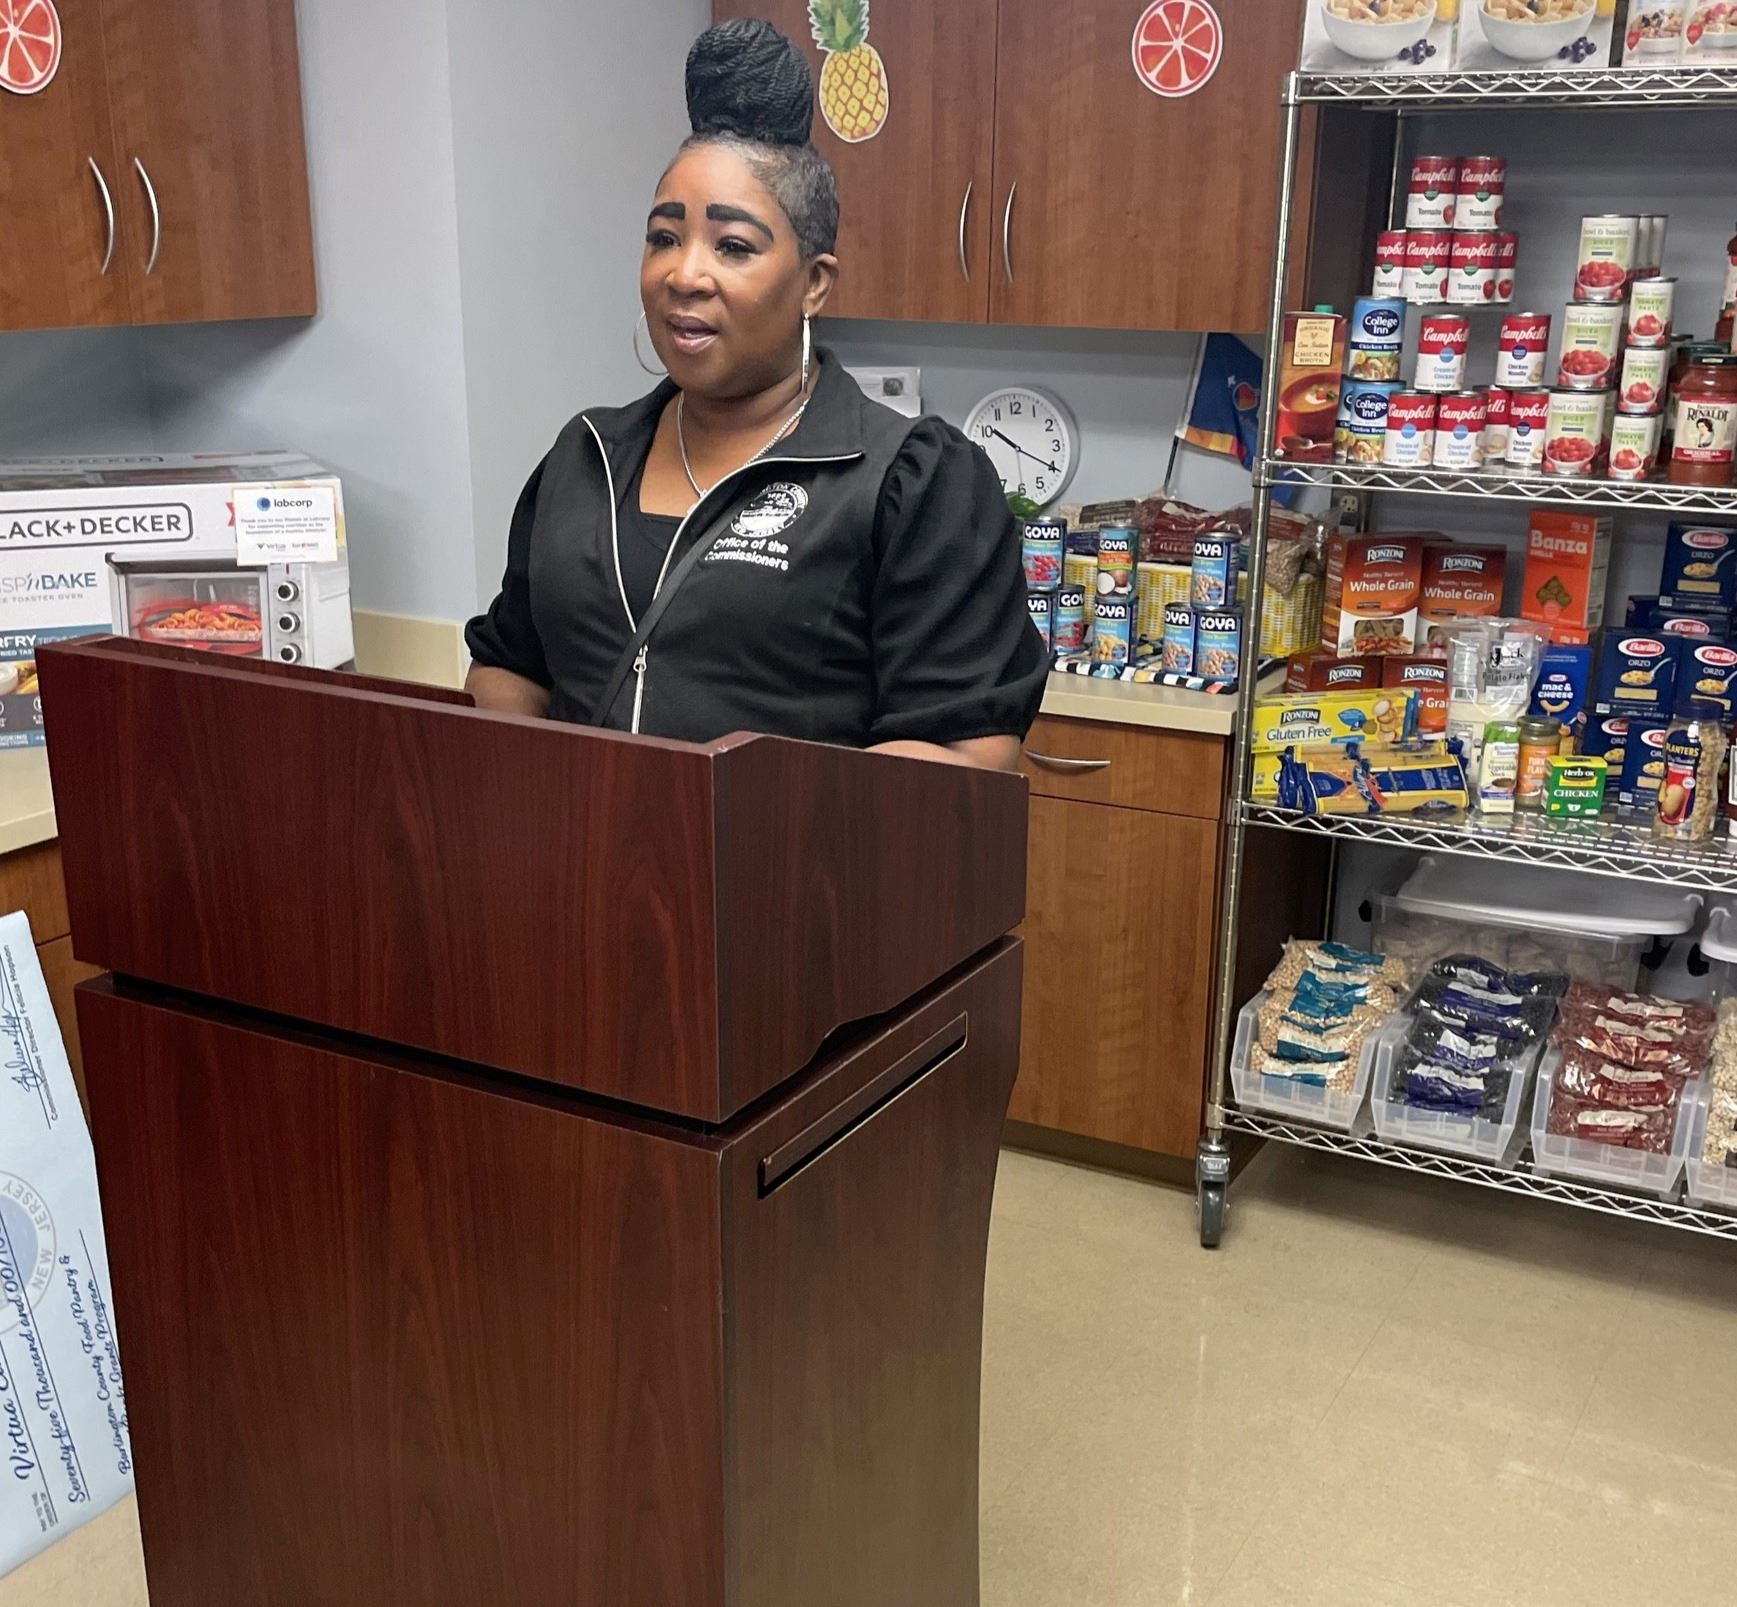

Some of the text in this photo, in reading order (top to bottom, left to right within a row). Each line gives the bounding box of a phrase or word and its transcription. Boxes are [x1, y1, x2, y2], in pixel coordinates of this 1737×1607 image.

[1418, 207, 1442, 216] Tomato
[1364, 315, 1398, 331] College
[1373, 326, 1389, 336] Inn
[1009, 401, 1022, 415] 12
[1032, 404, 1036, 418] 1
[1355, 399, 1387, 412] College
[994, 408, 1001, 422] 11
[1362, 409, 1377, 418] Inn
[1686, 406, 1729, 422] RINALDI
[981, 425, 993, 438] 10
[1044, 419, 1054, 432] 2
[1052, 439, 1061, 453] 3
[1048, 460, 1058, 473] 4
[1017, 482, 1026, 496] 6
[1035, 476, 1045, 490] 5
[274, 498, 313, 508] labcorp
[0, 514, 182, 540] ACK+DECKER
[1024, 525, 1061, 539] GOYA
[713, 536, 789, 554] Office of the
[1531, 529, 1588, 555] Banza
[1692, 534, 1725, 545] Barilla
[1194, 543, 1222, 556] OYA
[1367, 549, 1404, 562] RONZONI
[1691, 551, 1714, 559] ORZO
[1443, 557, 1484, 569] RONZONI
[1350, 579, 1415, 592] Whole Grain
[12, 594, 54, 603] TOASTER
[1424, 587, 1495, 601] Whole Grain
[1028, 599, 1048, 611] YA
[1165, 610, 1190, 625] OYA
[1629, 642, 1661, 653] Barilla
[1628, 659, 1652, 667] ORZO
[1704, 651, 1737, 662] Barilla
[1329, 668, 1362, 682] RONZONI
[1404, 667, 1445, 679] RONZONI
[1703, 667, 1726, 677] ORZO
[1542, 683, 1572, 692] mac &
[1282, 710, 1319, 722] RONZONI
[1266, 726, 1332, 741] Gluten Free
[1665, 743, 1699, 757] PLANTERS
[1553, 789, 1599, 798] CHICKEN
[4, 944, 17, 983] Hopson
[14, 983, 26, 1014] Felicia
[25, 1016, 39, 1053] Director
[2, 1179, 52, 1290] NEW JERSEY
[59, 1254, 70, 1265] &
[66, 1268, 85, 1319] Pantry
[8, 1294, 31, 1328] and
[87, 1278, 109, 1340] Program
[78, 1318, 96, 1354] Food
[19, 1328, 54, 1411] Thousand
[91, 1354, 110, 1401] County
[3, 1398, 36, 1480] Virtua
[108, 1402, 131, 1475] Burlington
